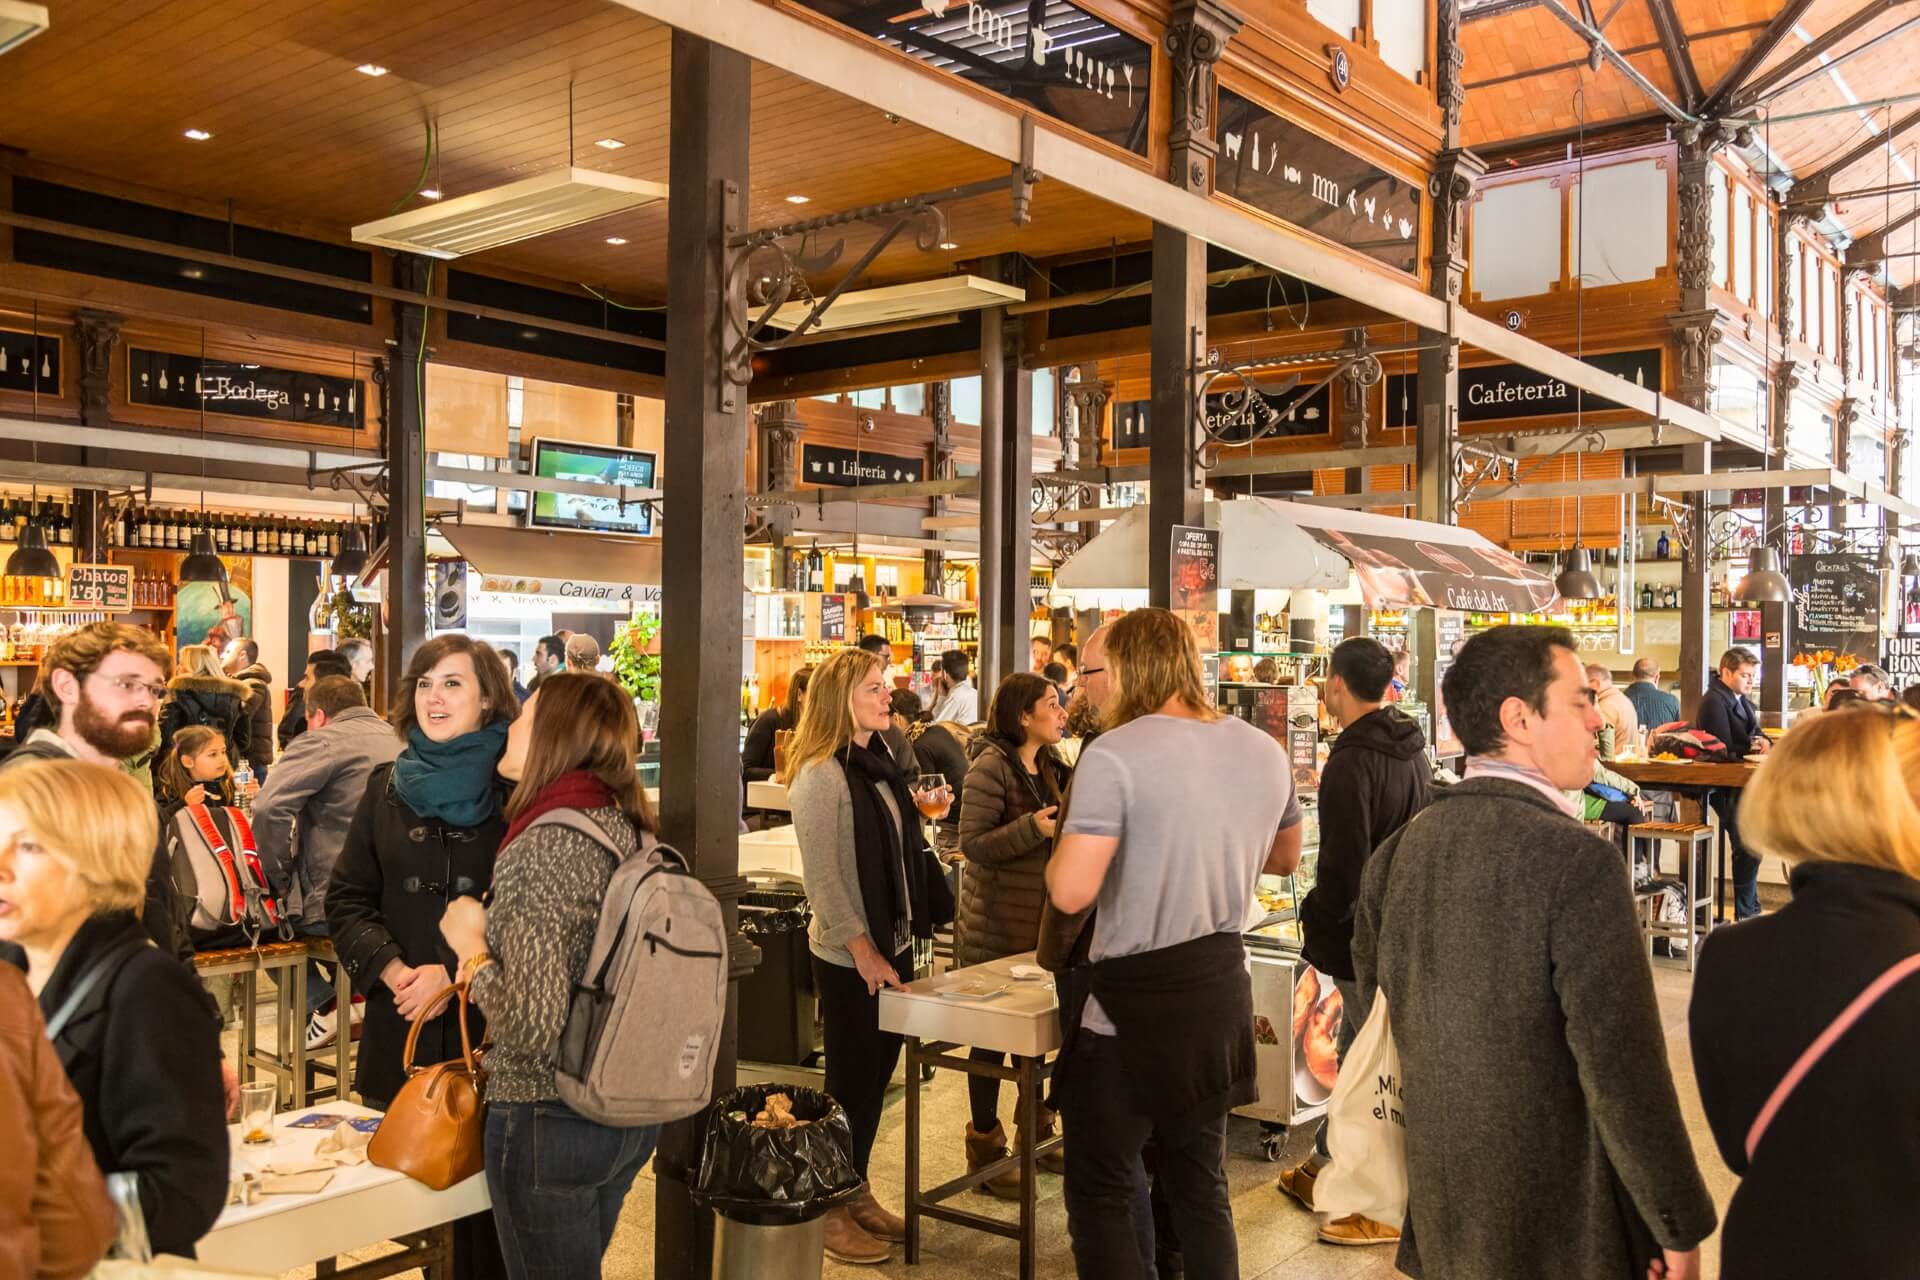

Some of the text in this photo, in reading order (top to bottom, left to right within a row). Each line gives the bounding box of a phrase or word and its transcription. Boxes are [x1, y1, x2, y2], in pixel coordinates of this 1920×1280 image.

[216, 376, 290, 410] Bodega
[1468, 379, 1568, 405] Cafetería
[1185, 532, 1207, 541] OFERTA
[71, 568, 127, 585] Chatos
[559, 581, 613, 599] Caviar
[621, 586, 633, 600] &
[1447, 587, 1509, 611] Café del Art
[1372, 1099, 1388, 1120] el
